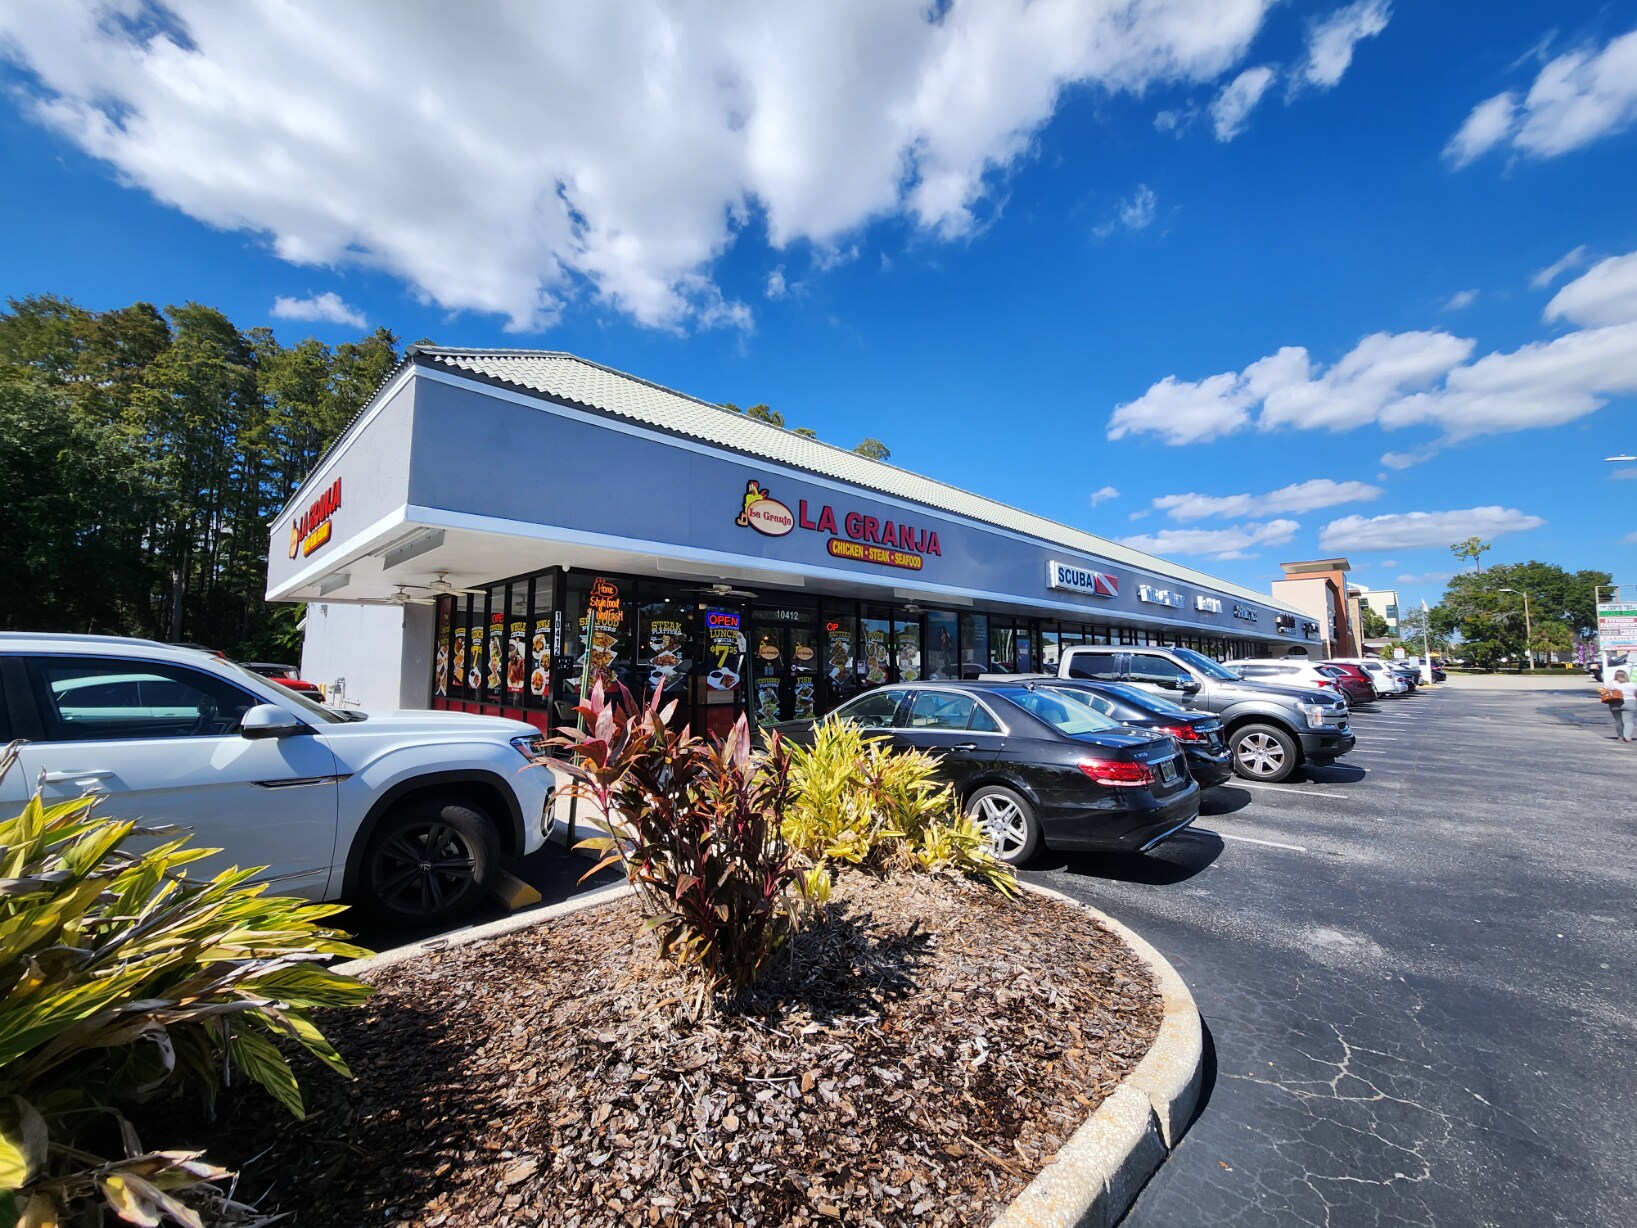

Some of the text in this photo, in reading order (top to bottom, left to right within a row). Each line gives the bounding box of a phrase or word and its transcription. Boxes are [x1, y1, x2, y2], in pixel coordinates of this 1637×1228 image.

[749, 507, 792, 526] La Granja
[799, 499, 942, 556] LA GRANJA
[832, 541, 921, 568] CHICKEN STEAK SEAFOOD
[1058, 567, 1093, 588] SCUBA
[709, 615, 738, 626] OPEN
[776, 610, 799, 620] 10412
[651, 621, 682, 631] STEAK
